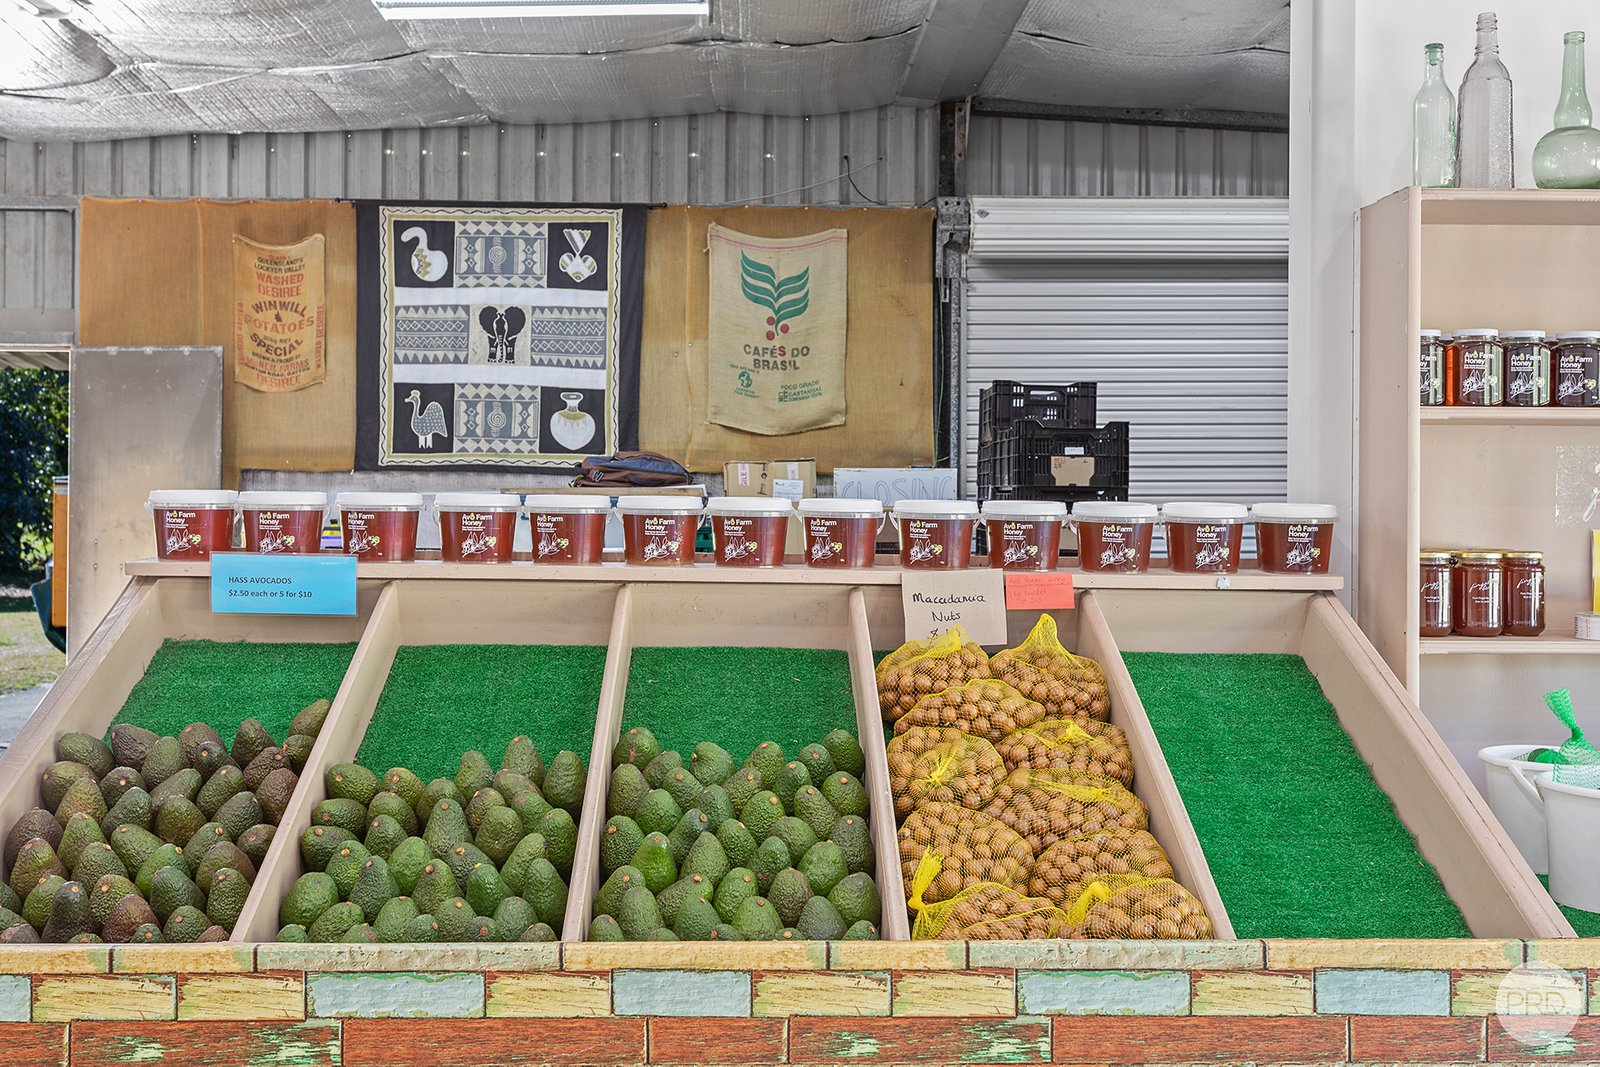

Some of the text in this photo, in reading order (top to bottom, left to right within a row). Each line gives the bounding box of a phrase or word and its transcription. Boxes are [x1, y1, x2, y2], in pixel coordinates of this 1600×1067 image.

[257, 256, 304, 266] QUEENSLAND'S
[254, 262, 306, 274] LOCKYER VALLEY
[256, 272, 304, 286] WASHED
[257, 284, 302, 298] DESIREE
[252, 300, 307, 318] WINWILL
[244, 314, 314, 334] POTATOES
[250, 332, 304, 356] SPECIAL
[744, 344, 810, 358] CAFÉS DO
[1465, 358, 1486, 366] Honey
[1560, 354, 1574, 362] Avo
[280, 358, 310, 372] FARMS
[753, 358, 800, 371] BRASIL
[256, 374, 301, 388] DESIREE
[166, 510, 178, 518] Avo
[259, 512, 272, 520] Avo
[462, 512, 475, 520] Avo
[644, 516, 658, 525] Avo
[724, 518, 736, 526] Avo
[810, 518, 821, 526] Avo
[910, 520, 922, 528] Avo
[644, 524, 666, 532] Honey
[1003, 522, 1016, 530] Avo
[910, 527, 928, 535] Honey
[228, 589, 249, 598] $2.50
[250, 590, 268, 598] each
[286, 590, 296, 598] for
[298, 590, 312, 598] $10
[932, 611, 961, 622] Nuts
